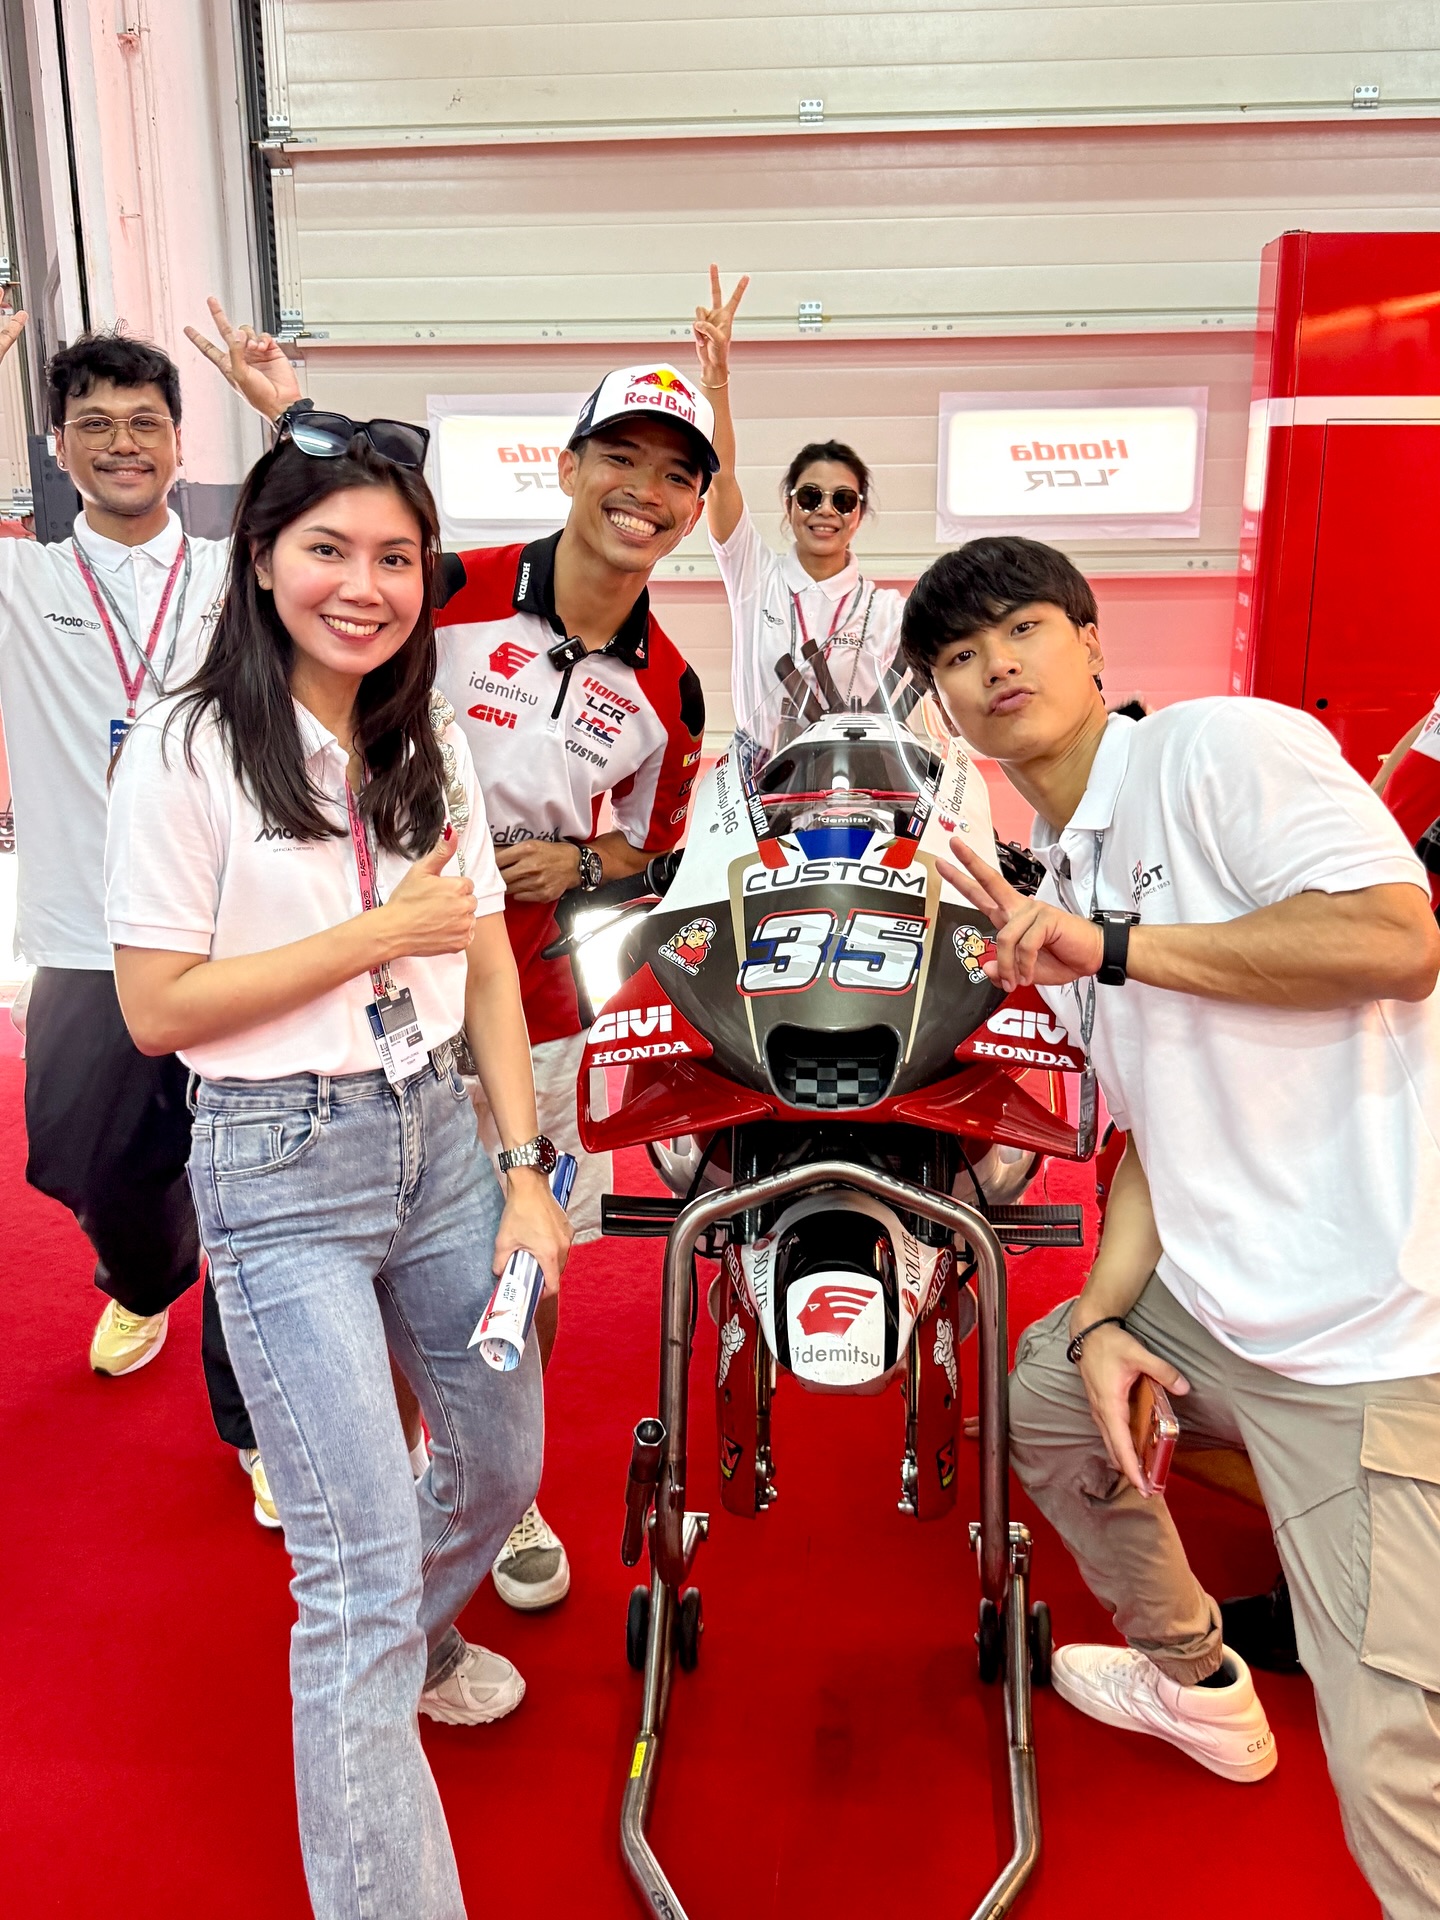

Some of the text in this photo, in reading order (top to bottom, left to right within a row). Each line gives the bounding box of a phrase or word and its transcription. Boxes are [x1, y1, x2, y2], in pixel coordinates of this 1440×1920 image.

[624, 392, 696, 425] Red Bull
[517, 562, 530, 601] HONDA
[469, 671, 538, 705] idemitsu
[582, 677, 640, 714] Honda
[467, 704, 518, 729] GIVI
[575, 711, 622, 743] HRC
[586, 696, 626, 725] LCR
[565, 740, 609, 768] CUSTOM
[716, 765, 739, 835] idemitsu IRG
[946, 771, 967, 815] idemitsu
[748, 794, 770, 837] CHANTRA
[746, 861, 926, 894] CUSTOM
[893, 920, 920, 933] SC
[736, 907, 931, 998] 35
[588, 1005, 672, 1044] GIVI
[987, 1008, 1068, 1045] GIV
[592, 1041, 693, 1065] HONDA
[972, 1041, 1077, 1068] HONDA
[902, 1231, 921, 1292] SOLIZE
[795, 1342, 881, 1367] idemitsu
